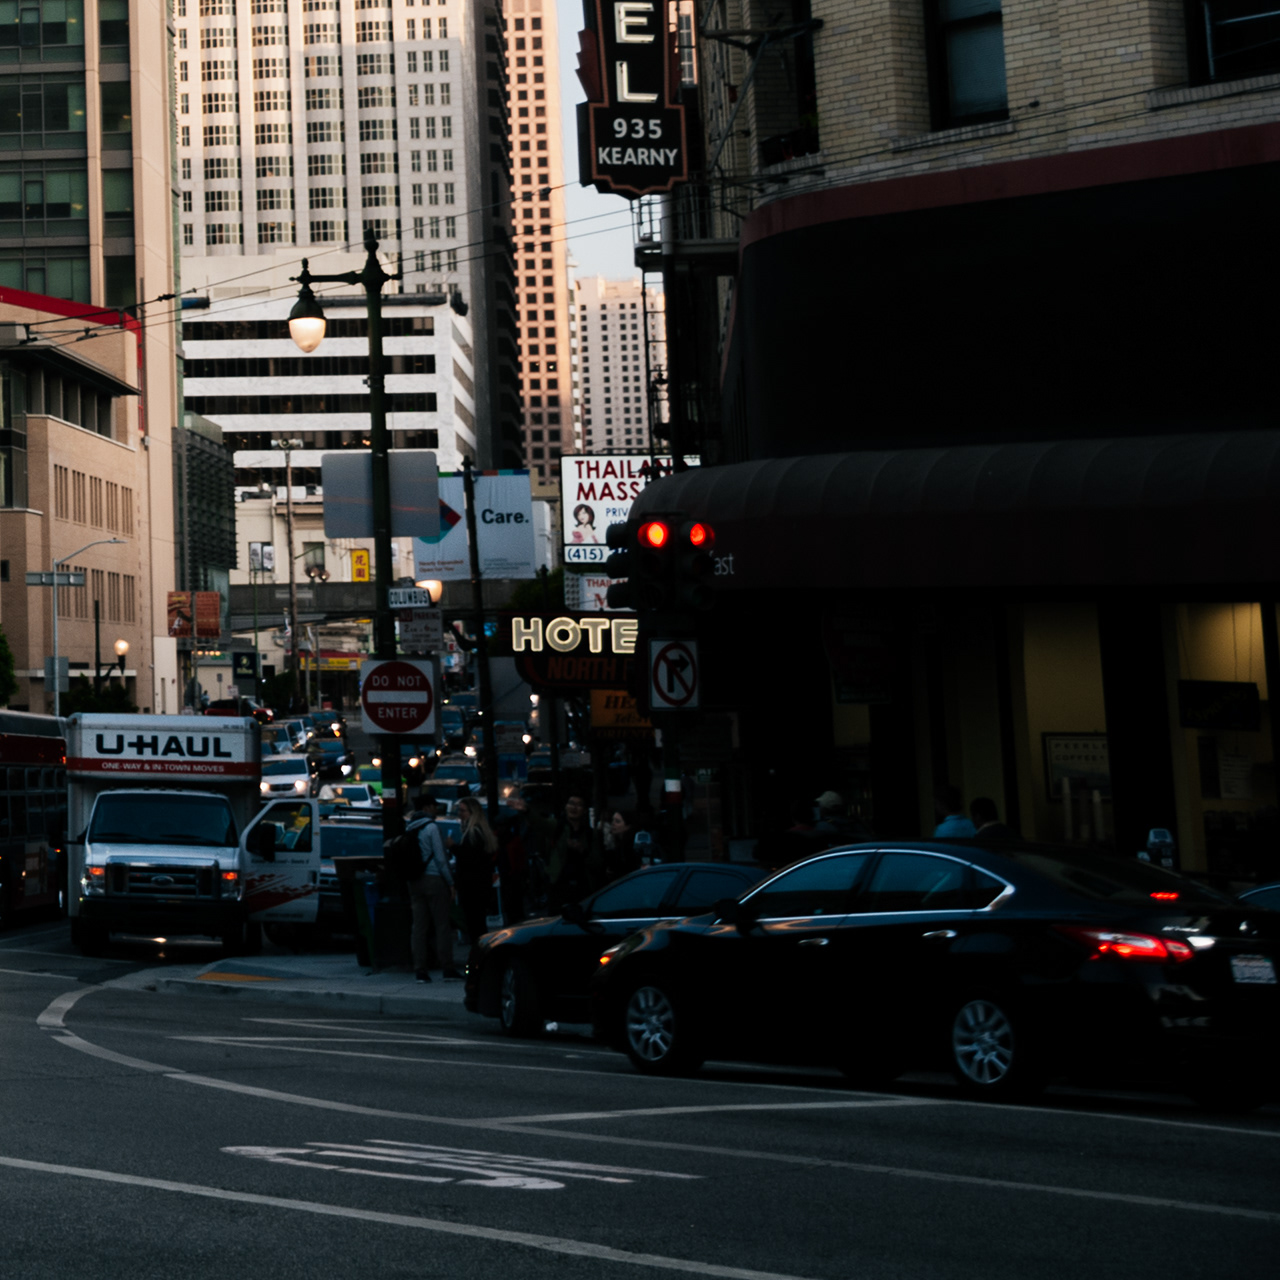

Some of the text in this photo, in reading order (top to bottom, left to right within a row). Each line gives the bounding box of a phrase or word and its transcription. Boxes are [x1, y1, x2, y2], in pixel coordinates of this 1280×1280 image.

[612, 118, 663, 140] 935
[597, 146, 679, 167] KEARNY
[575, 460, 674, 479] THAILAN
[576, 481, 640, 502] MASS
[481, 508, 530, 524] Care.
[605, 507, 629, 518] PRIV
[567, 547, 604, 561] (415)
[389, 590, 428, 605] COLUMBUS
[511, 616, 640, 654] HOTE
[546, 656, 617, 681] NORTH
[371, 675, 422, 688] DO NOT
[377, 706, 419, 719] ENTER
[95, 733, 232, 758] U-HAUL
[101, 761, 225, 773] ONE-WAY & IN-TOWN MOVES
